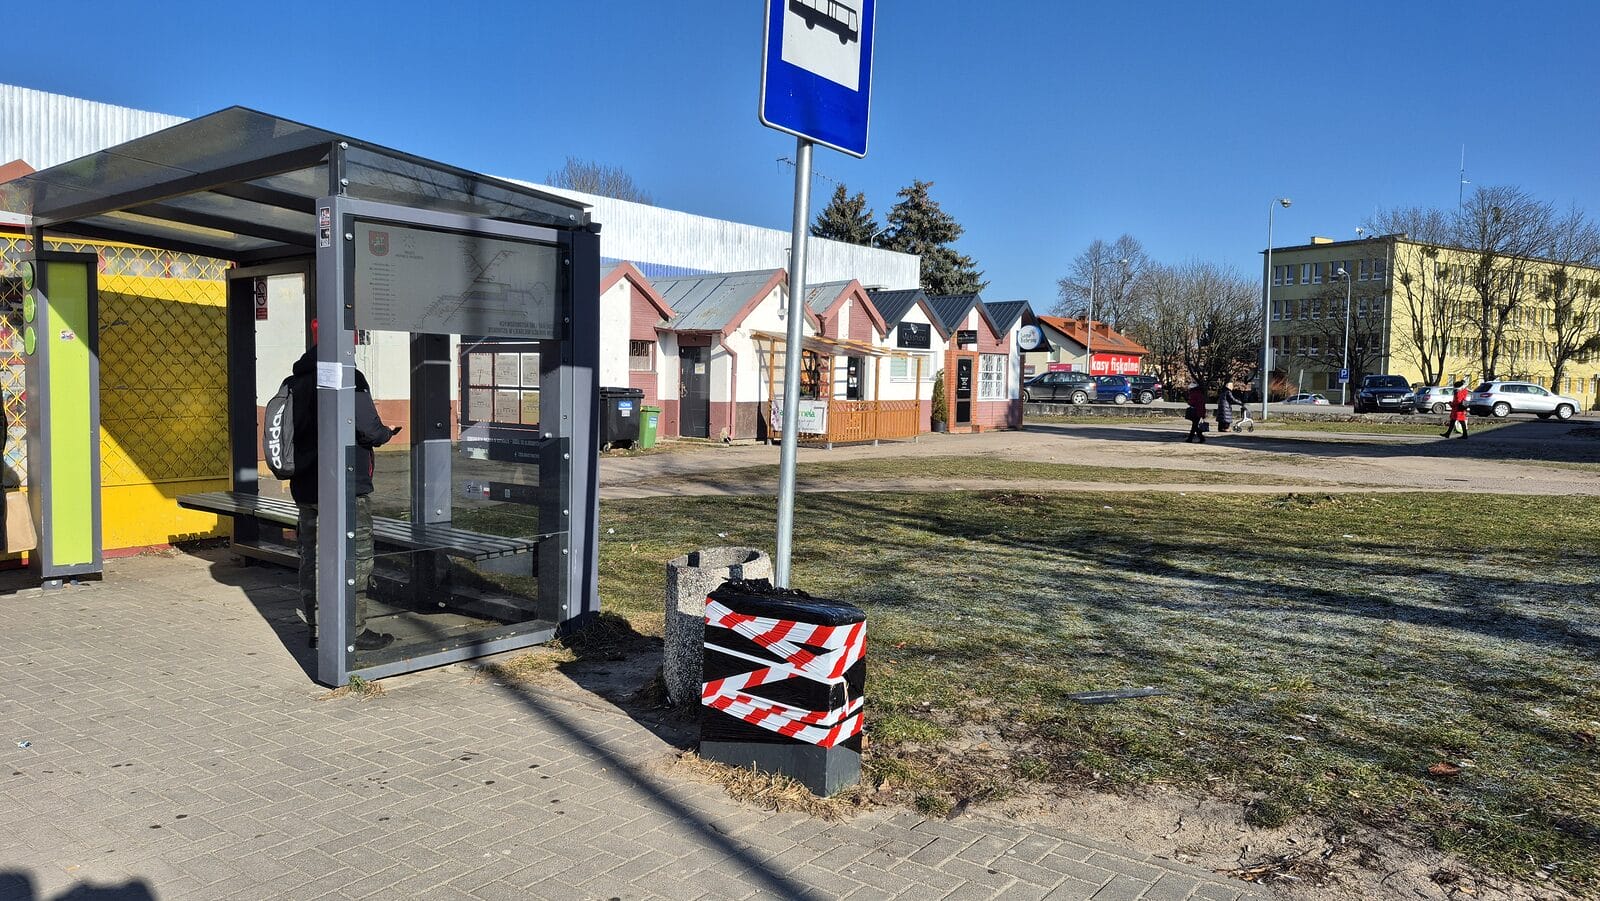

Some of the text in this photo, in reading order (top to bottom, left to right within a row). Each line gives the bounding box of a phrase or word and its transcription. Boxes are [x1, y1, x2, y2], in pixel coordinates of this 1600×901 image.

[1091, 356, 1139, 375] kasy fiskalne
[1340, 369, 1347, 377] P
[269, 404, 285, 470] adidas
